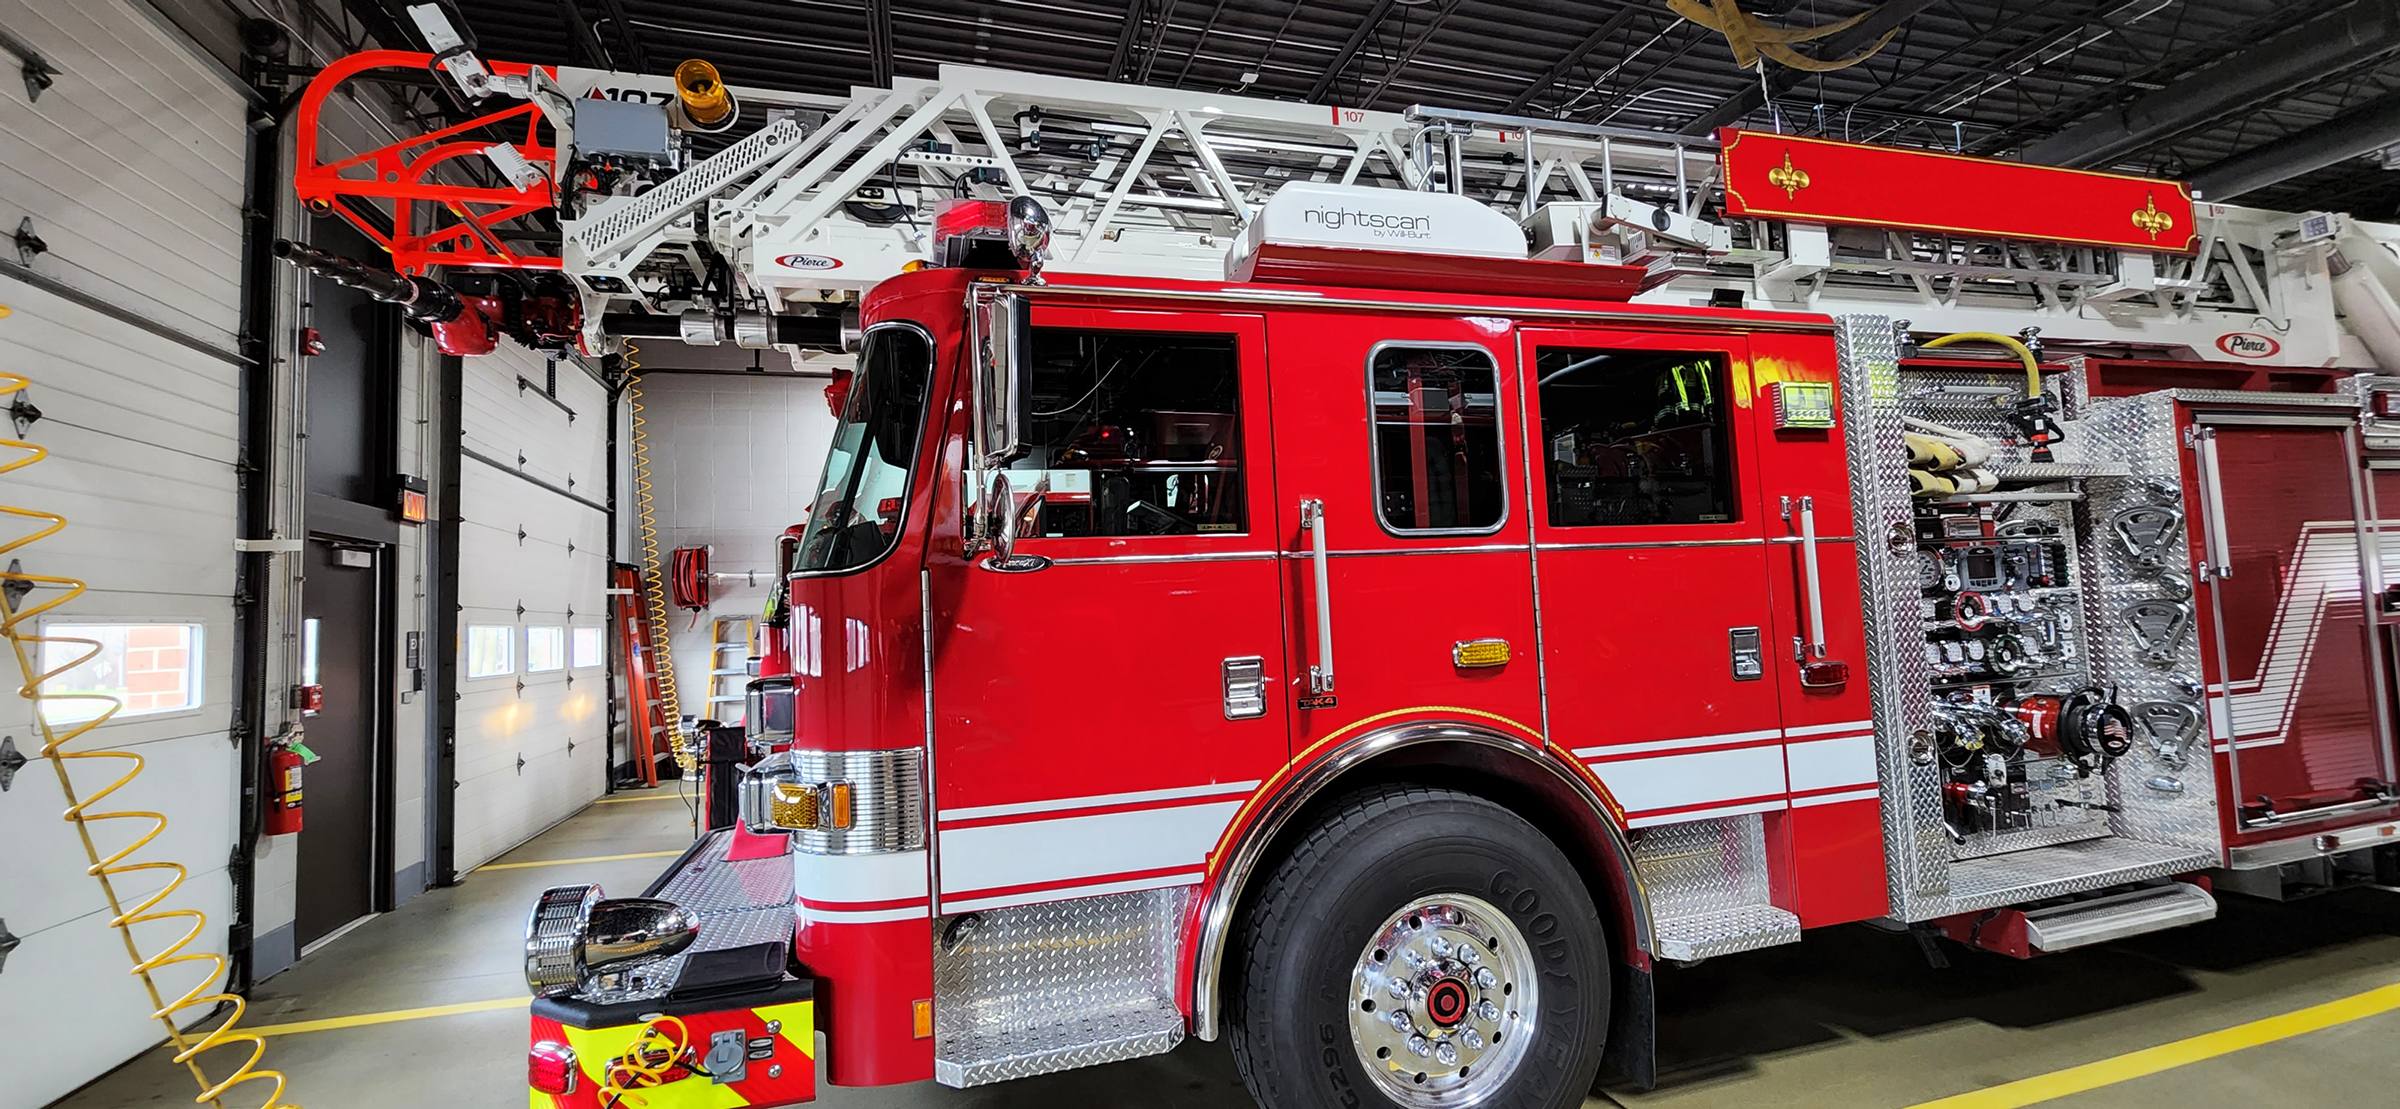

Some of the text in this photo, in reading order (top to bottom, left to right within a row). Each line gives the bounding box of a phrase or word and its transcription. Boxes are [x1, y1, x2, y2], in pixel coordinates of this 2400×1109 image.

[605, 87, 674, 106] 107
[1344, 111, 1364, 122] 107
[1304, 205, 1430, 230] nightscan
[1374, 229, 1385, 239] by
[790, 255, 828, 267] Pierce
[2230, 335, 2267, 352] Pierce
